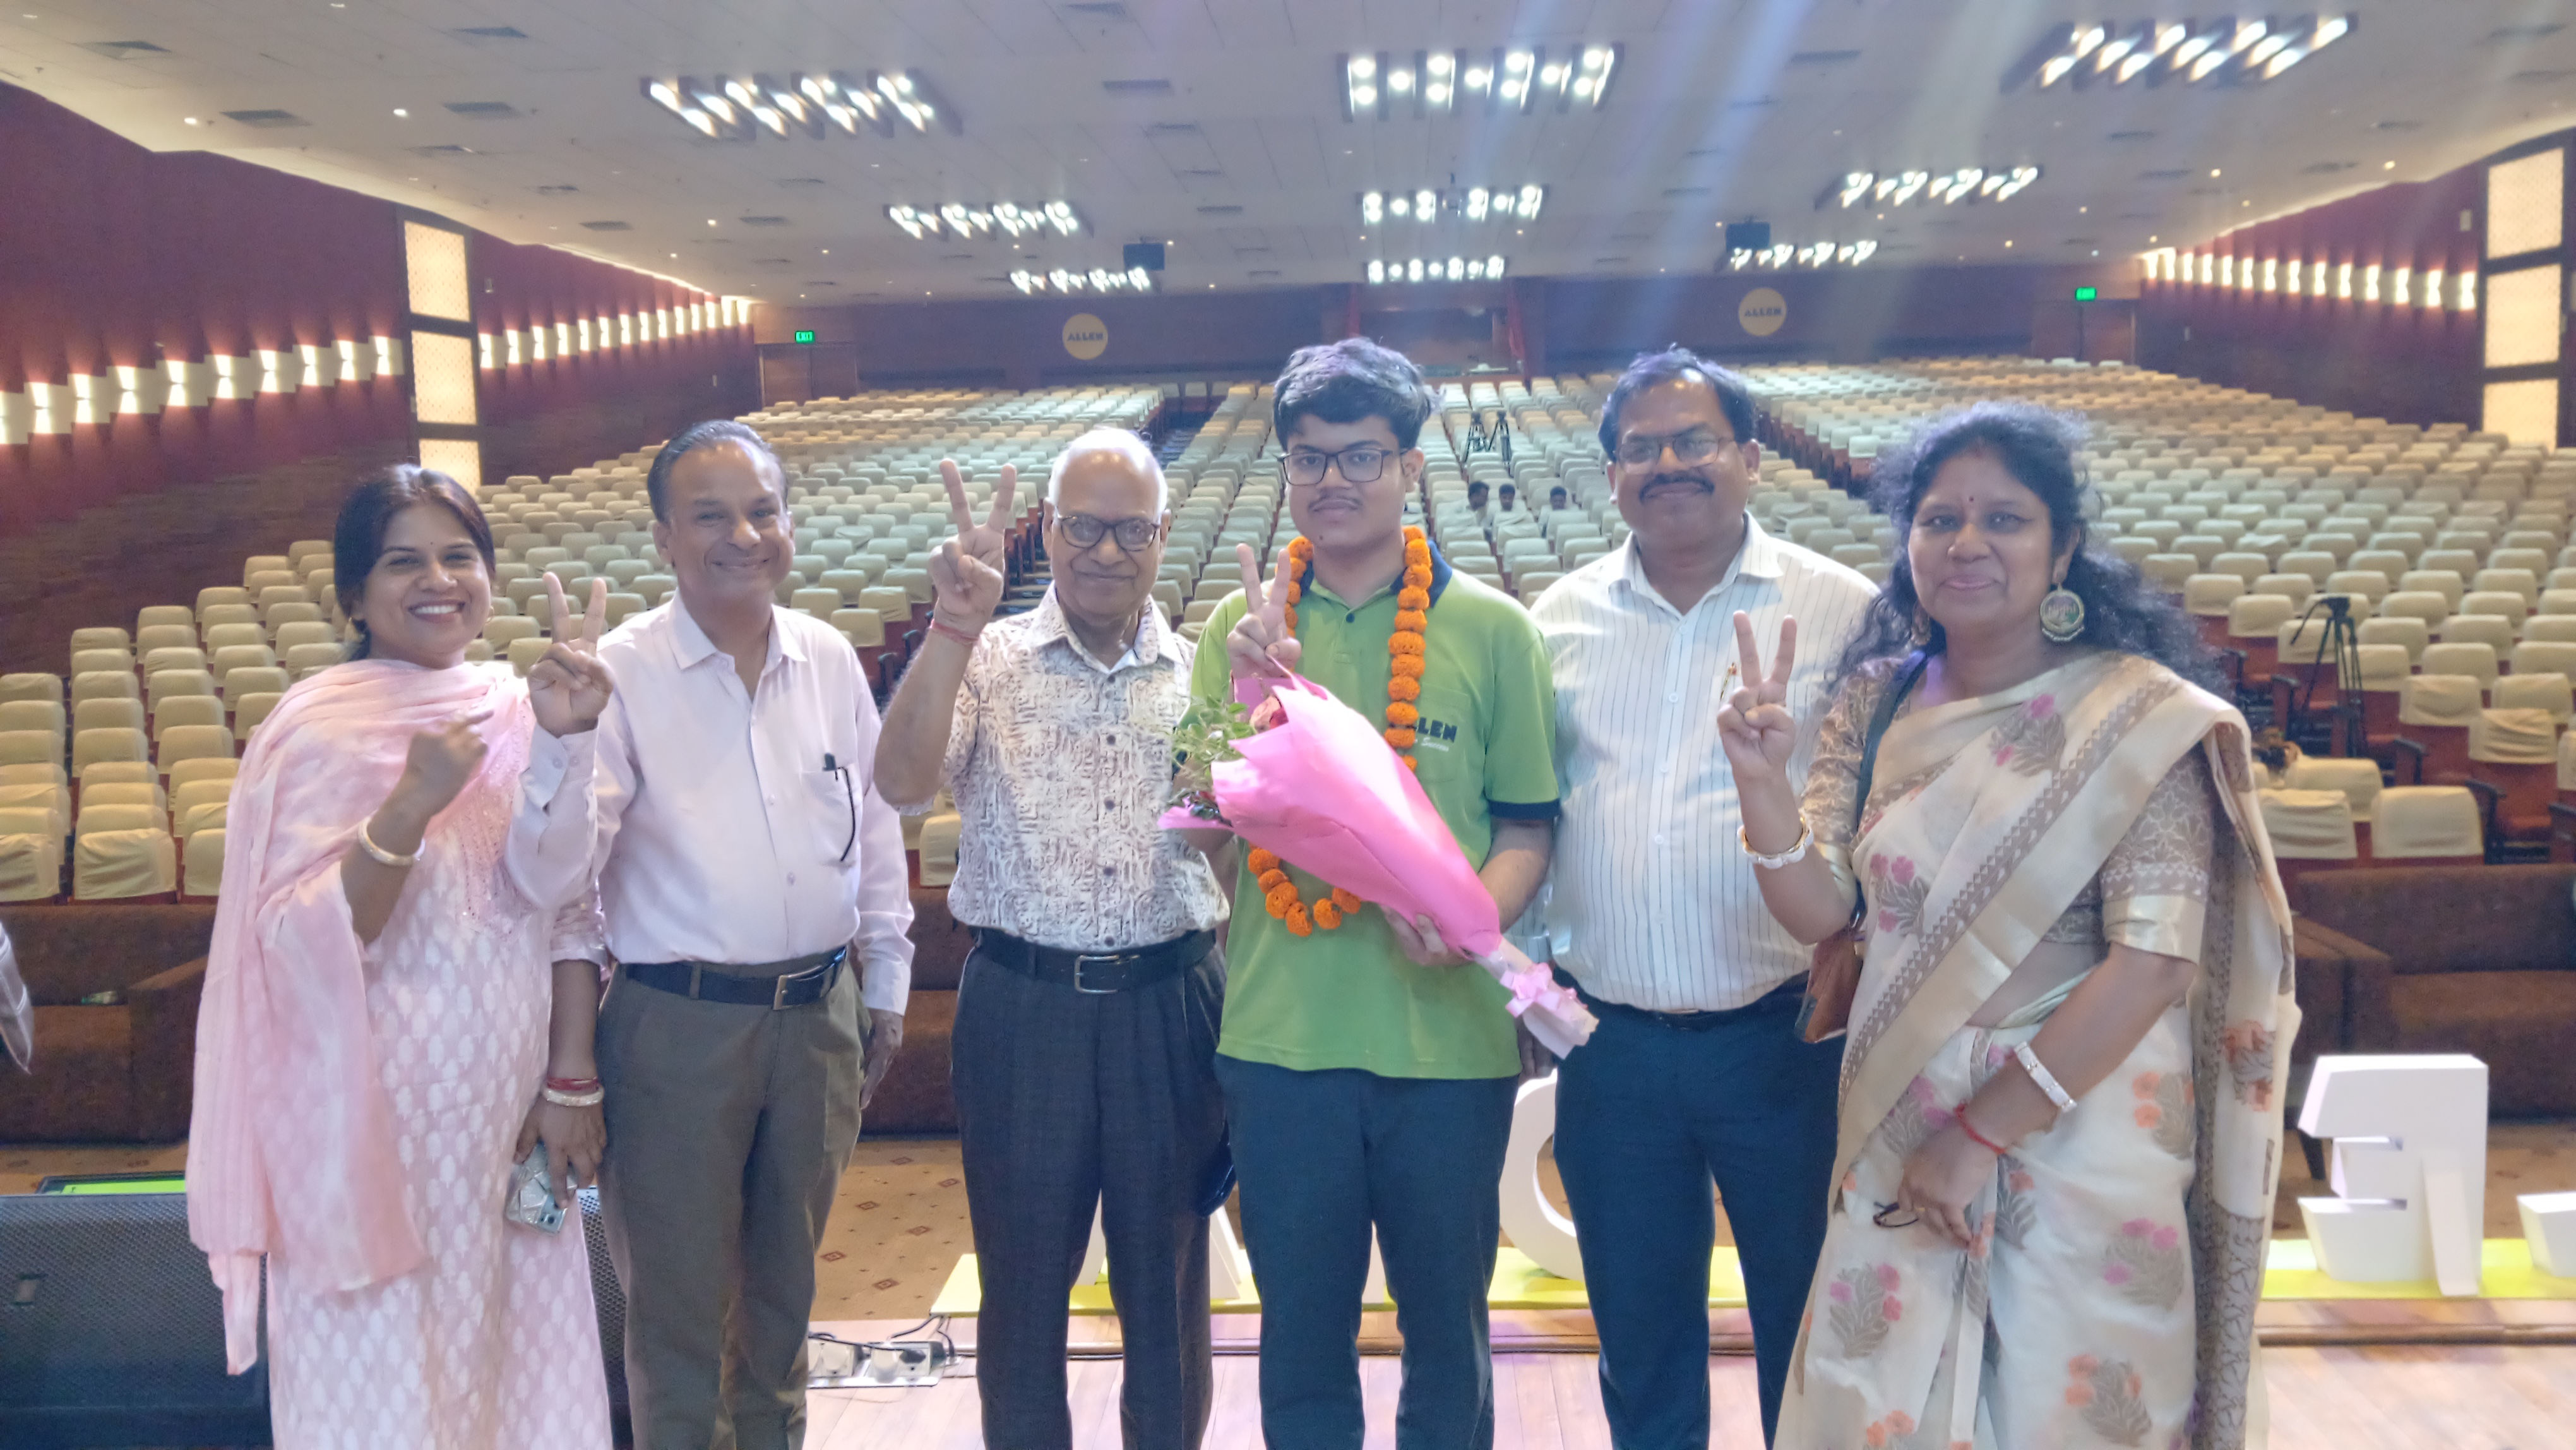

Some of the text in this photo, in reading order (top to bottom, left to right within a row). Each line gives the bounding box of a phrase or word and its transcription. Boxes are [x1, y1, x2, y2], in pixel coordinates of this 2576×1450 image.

[1744, 307, 1782, 317] ALLEN
[796, 332, 813, 341] EXIT
[1067, 332, 1104, 342] ALLEN
[1411, 716, 1458, 743] LEN
